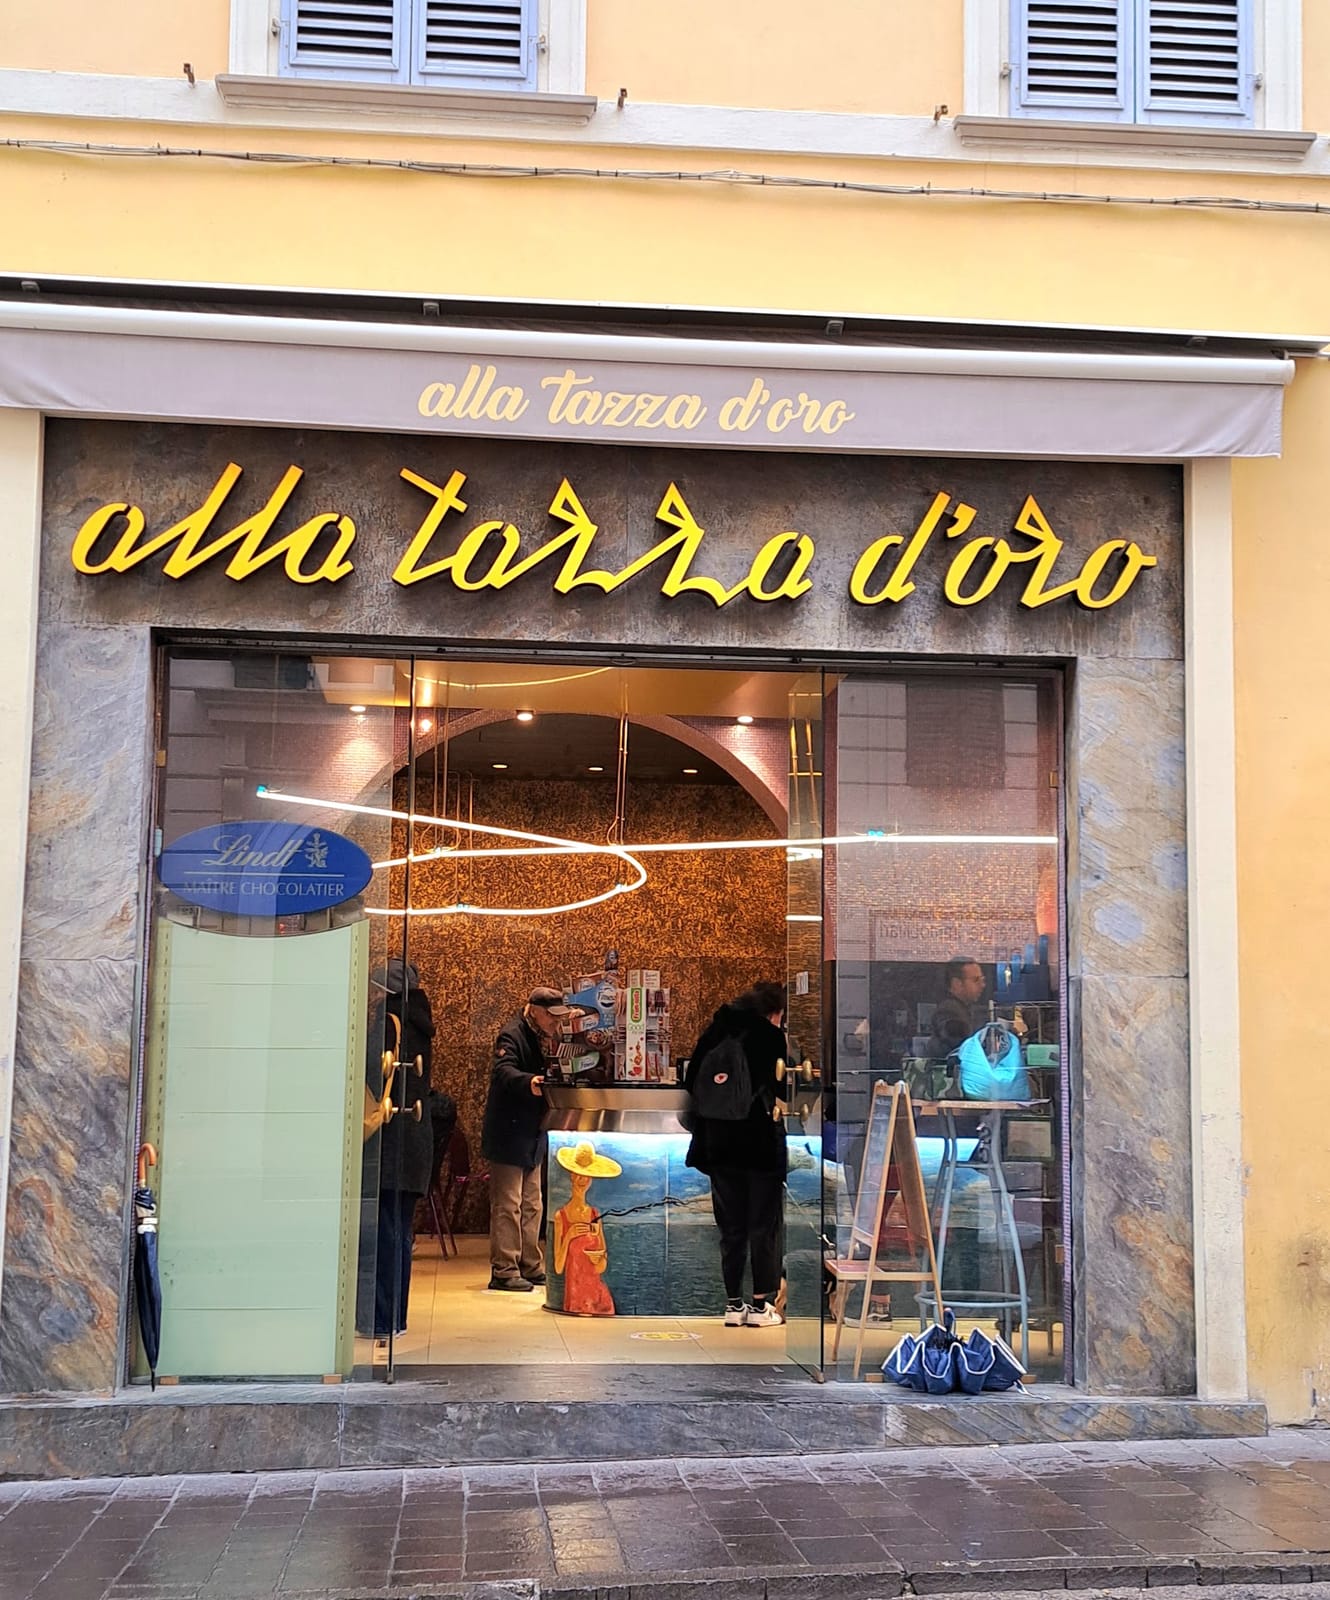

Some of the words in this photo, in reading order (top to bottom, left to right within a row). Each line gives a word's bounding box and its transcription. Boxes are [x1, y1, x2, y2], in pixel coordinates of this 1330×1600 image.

[418, 364, 530, 423] alla
[541, 369, 707, 430] tazza
[719, 377, 855, 434] d'oro
[70, 462, 357, 584] alla
[393, 468, 815, 608] tazza
[850, 491, 1158, 609] d'oro
[201, 833, 304, 868] Lindt
[183, 877, 236, 895] MAÎTRE
[240, 881, 345, 897] CHOCOLATIER
